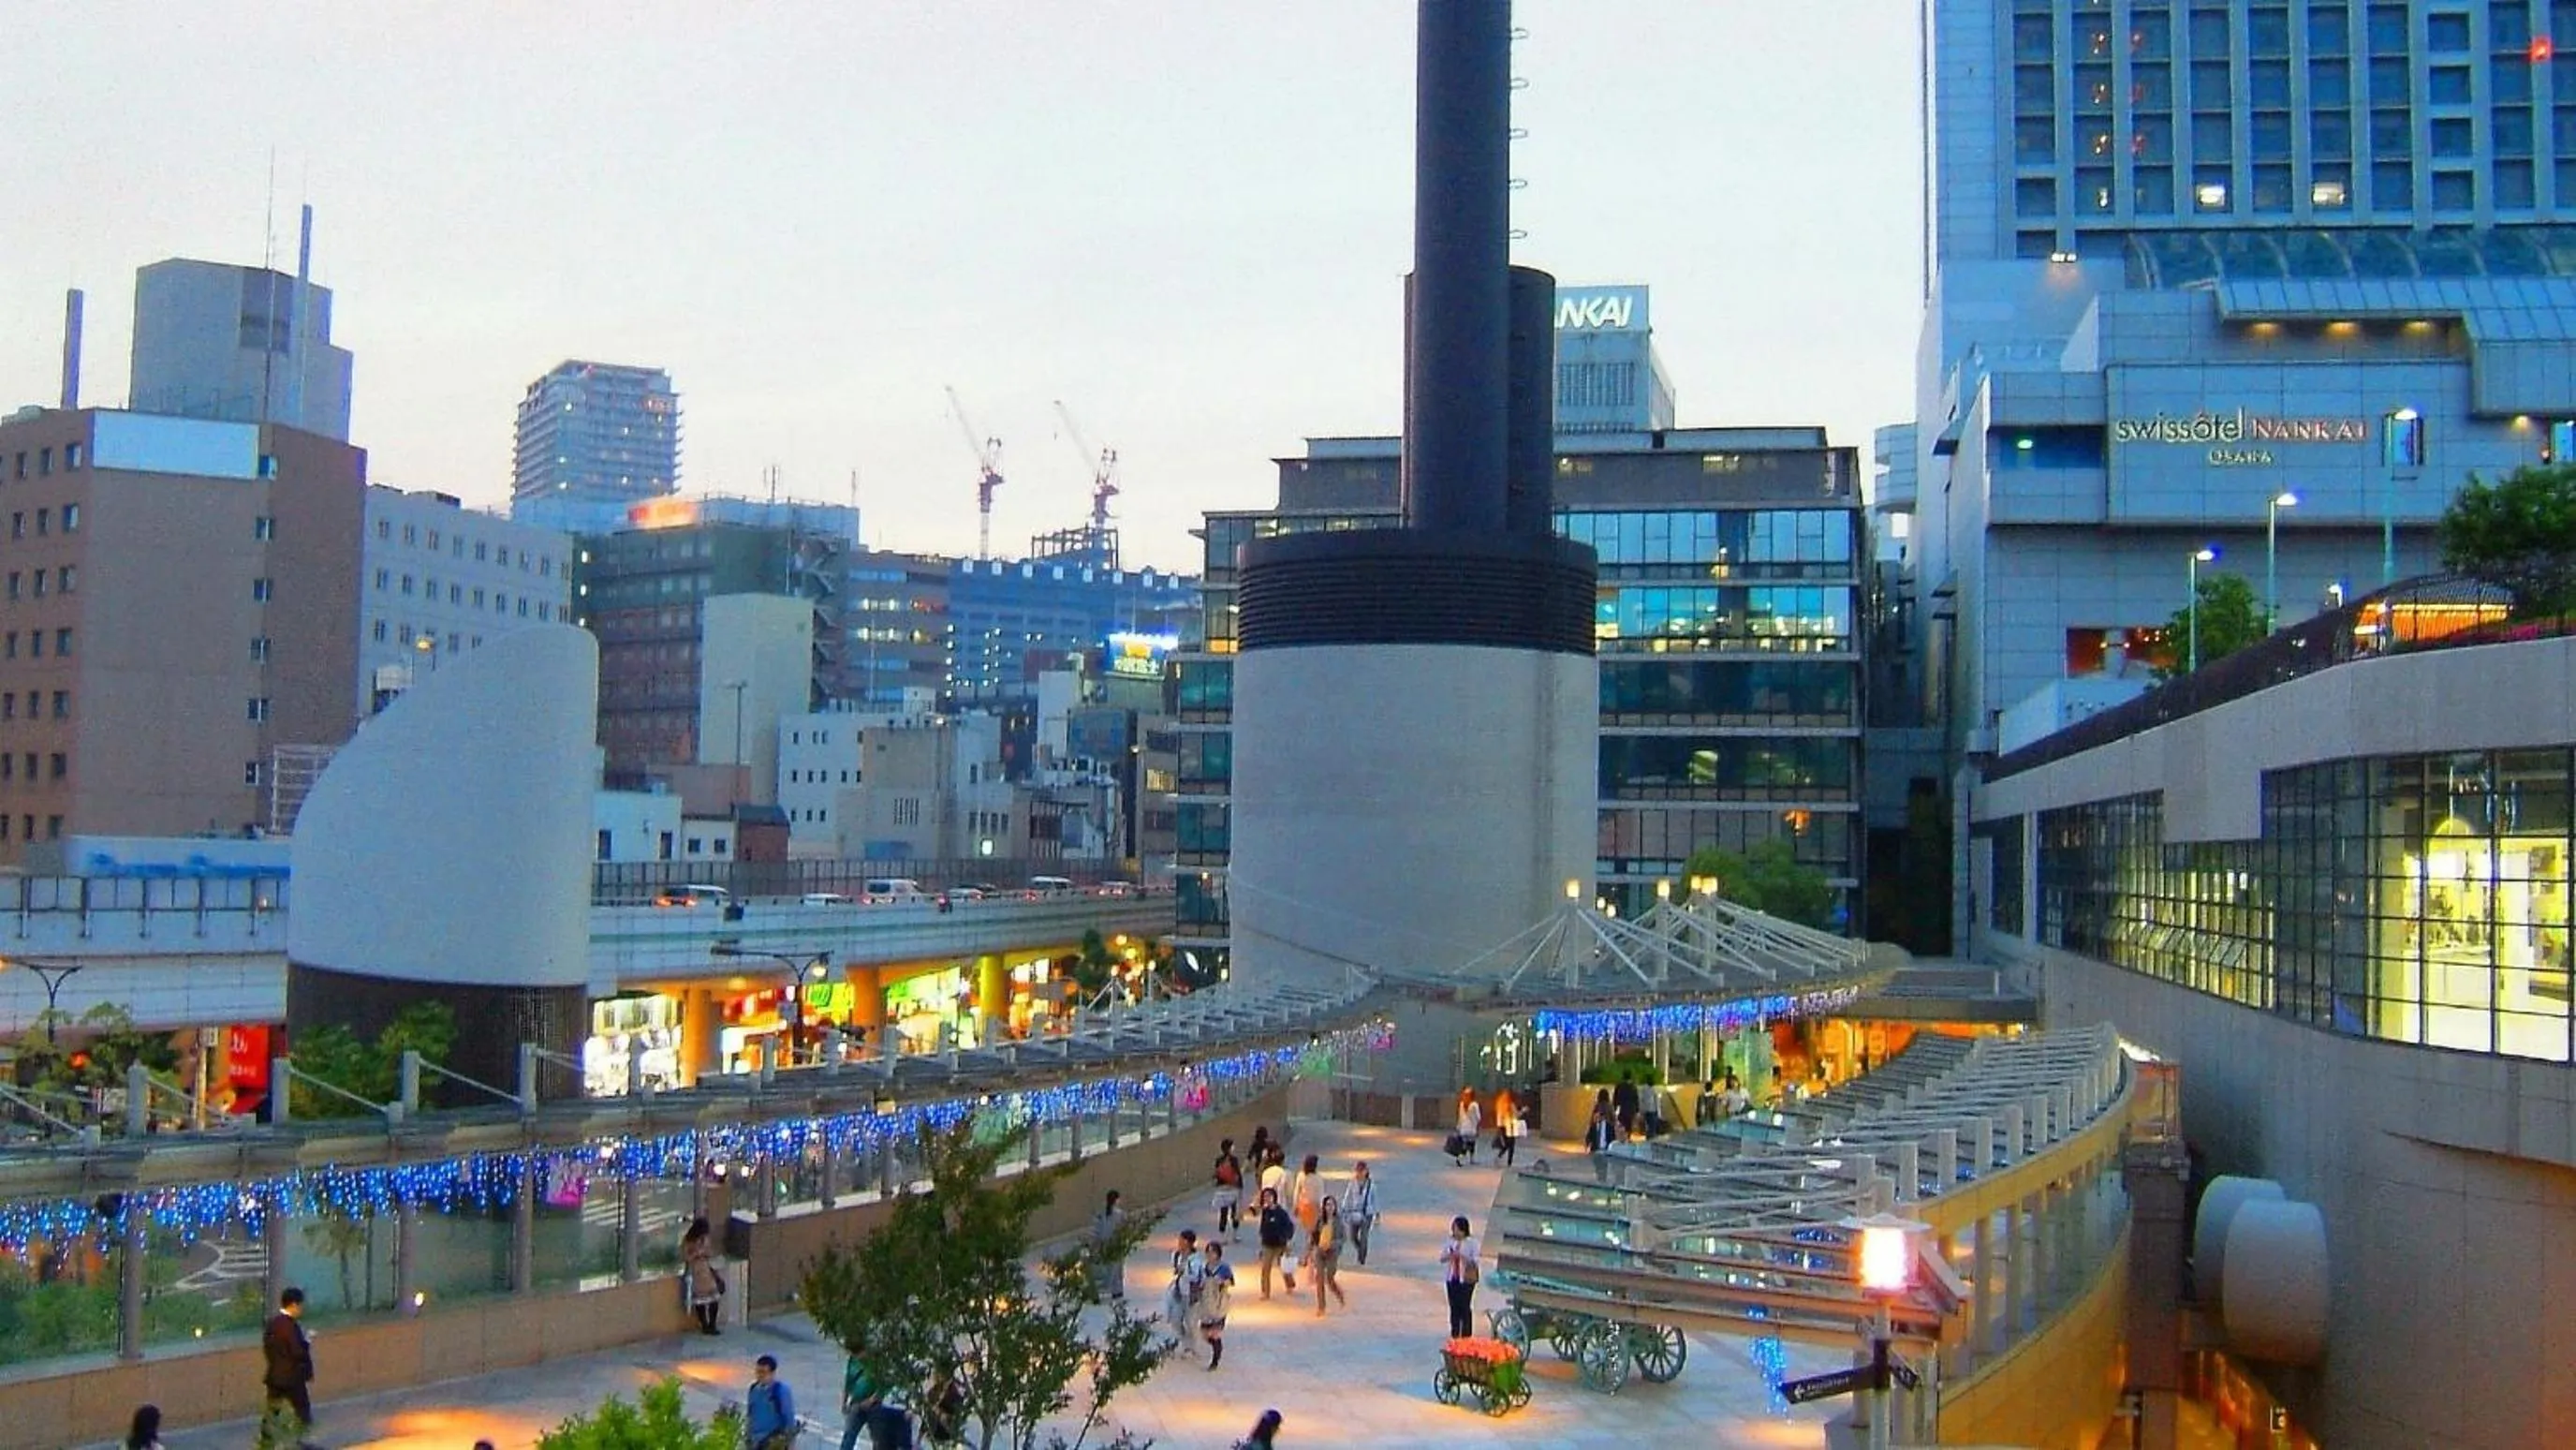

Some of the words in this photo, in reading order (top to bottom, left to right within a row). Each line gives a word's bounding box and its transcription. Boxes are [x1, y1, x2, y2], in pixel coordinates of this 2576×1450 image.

[1554, 296, 1633, 328] NKAI
[2115, 407, 2245, 442] swissôtel
[2252, 418, 2367, 440] NANKAI
